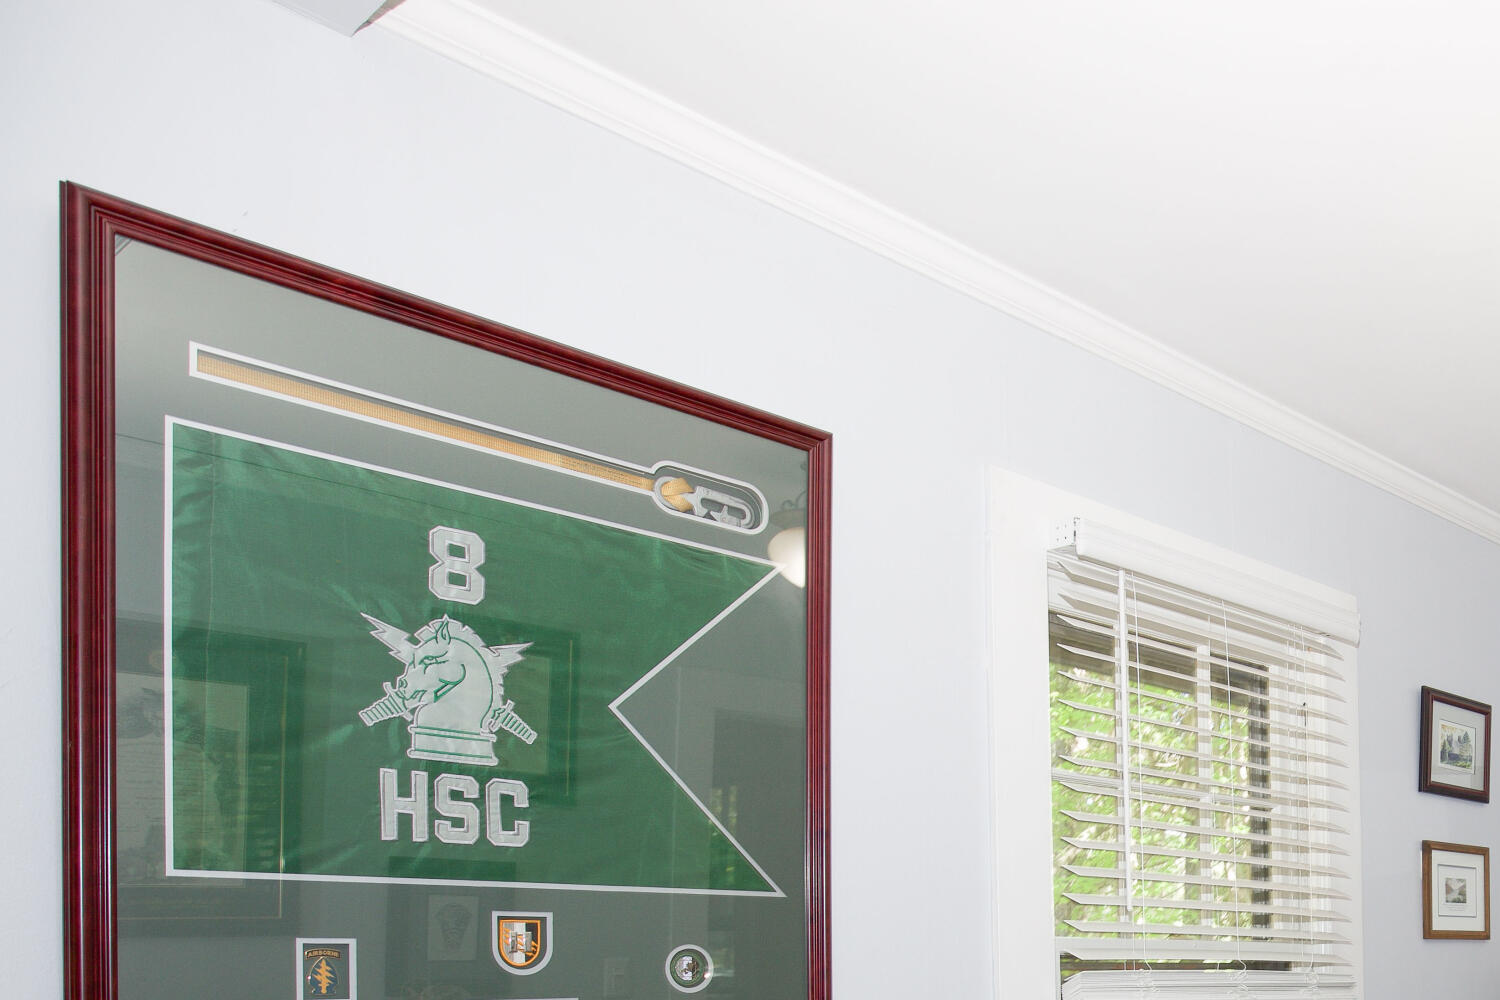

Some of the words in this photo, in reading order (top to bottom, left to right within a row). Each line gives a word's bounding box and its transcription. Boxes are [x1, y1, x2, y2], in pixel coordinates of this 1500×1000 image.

[428, 525, 486, 605] 8
[379, 767, 530, 848] HSC
[307, 950, 340, 958] AIRBORNE
